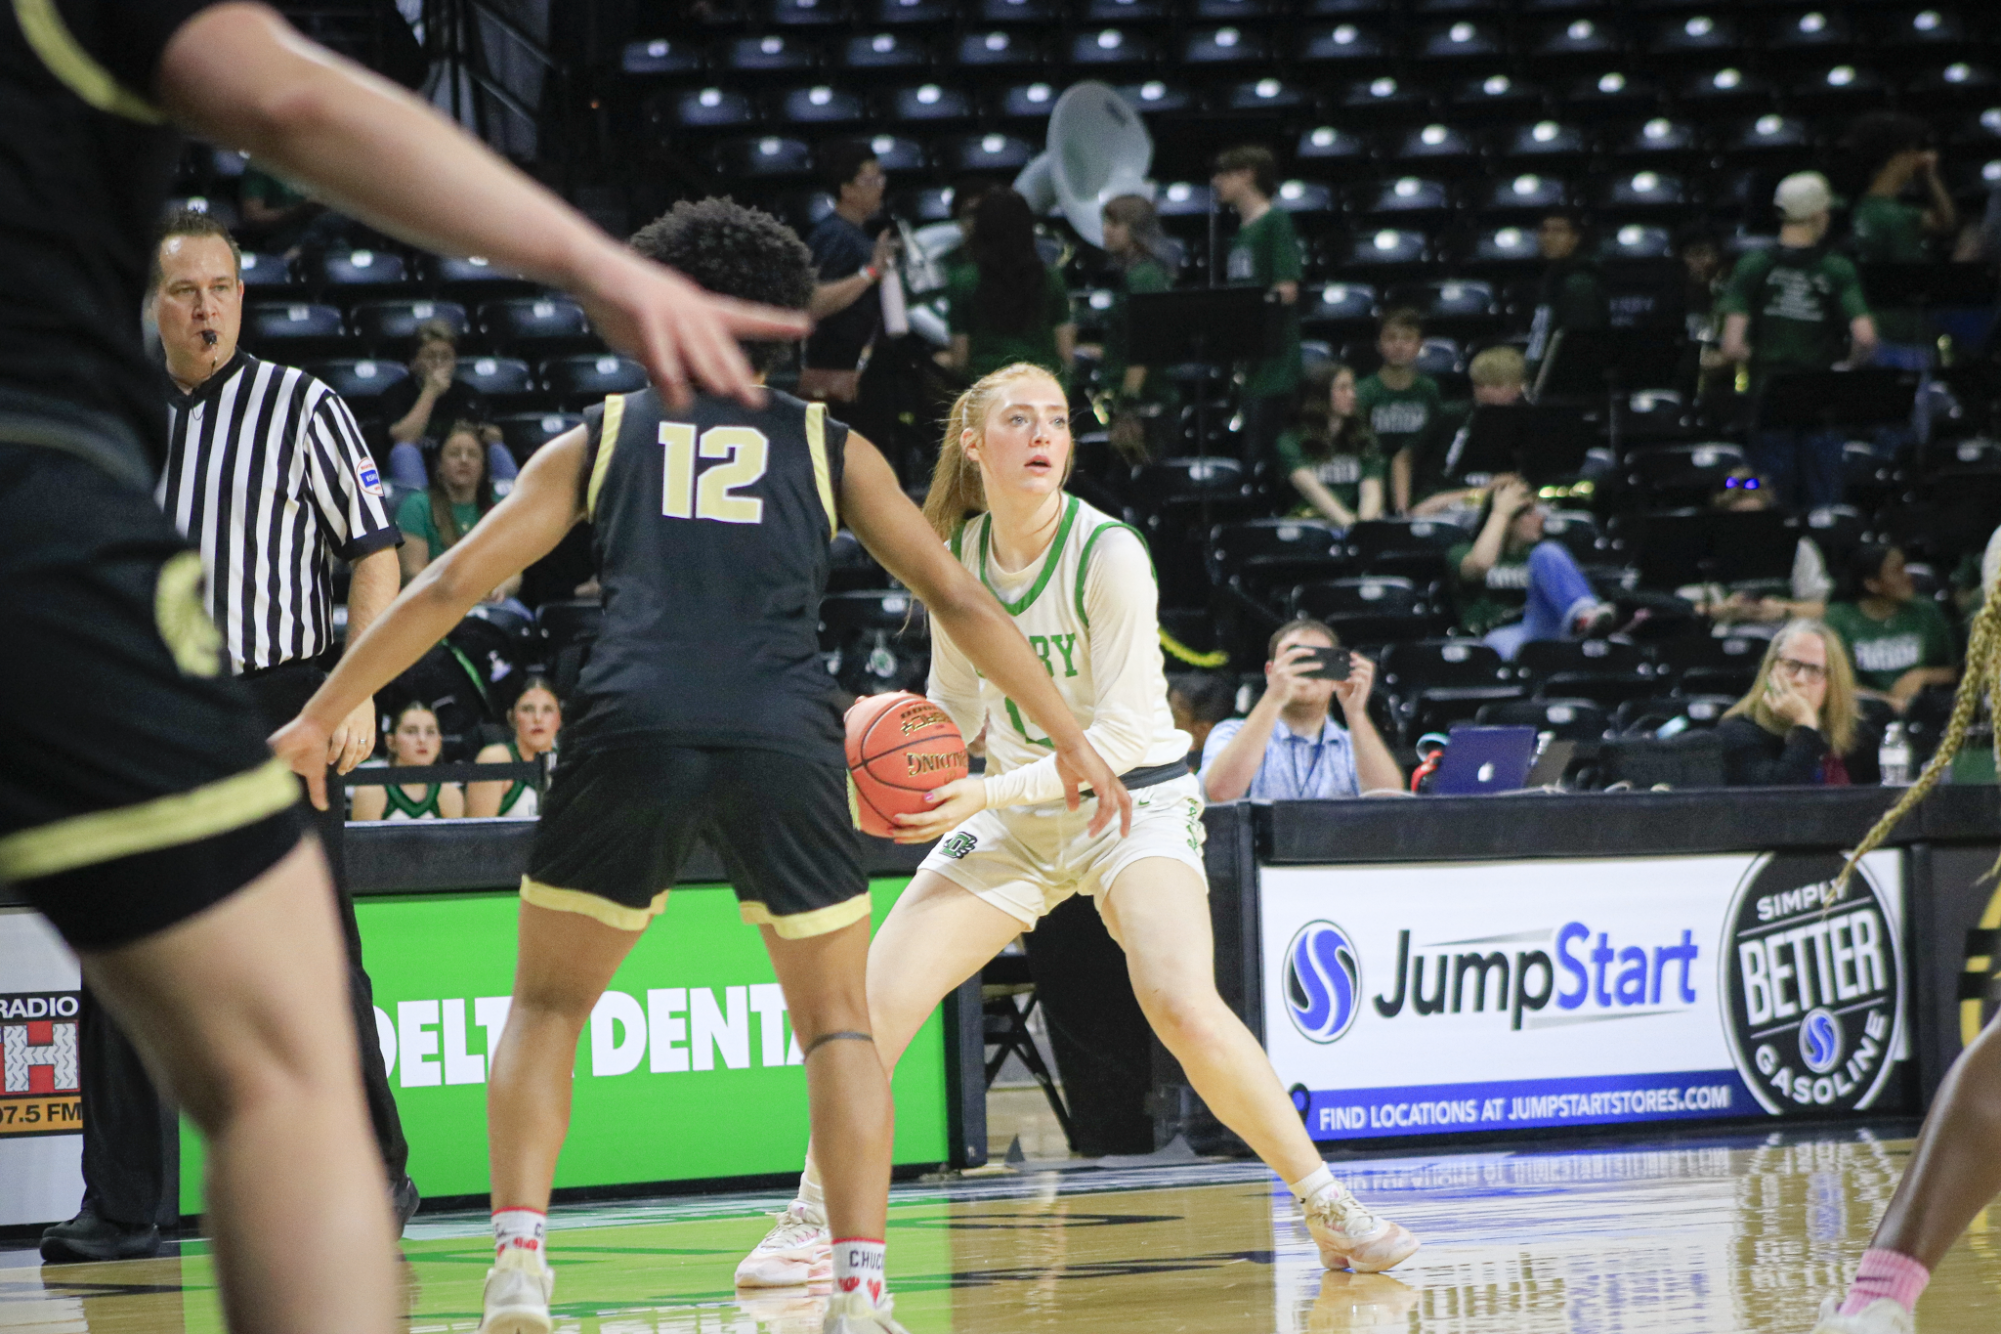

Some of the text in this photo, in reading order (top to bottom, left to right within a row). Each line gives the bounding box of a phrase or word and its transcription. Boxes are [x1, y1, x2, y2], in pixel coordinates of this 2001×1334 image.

[658, 421, 769, 524] 12
[1372, 921, 1699, 1031] JumpStart
[1739, 909, 1886, 1026] BETTER
[373, 996, 574, 1088] ELT
[1756, 1009, 1890, 1104] GASOLINE
[0, 1102, 82, 1125] 7.5 FM
[1319, 1085, 1731, 1131] FIND LOCATIONS AT JUMPSTARTSTORES.COM
[849, 1248, 886, 1271] CHUC
